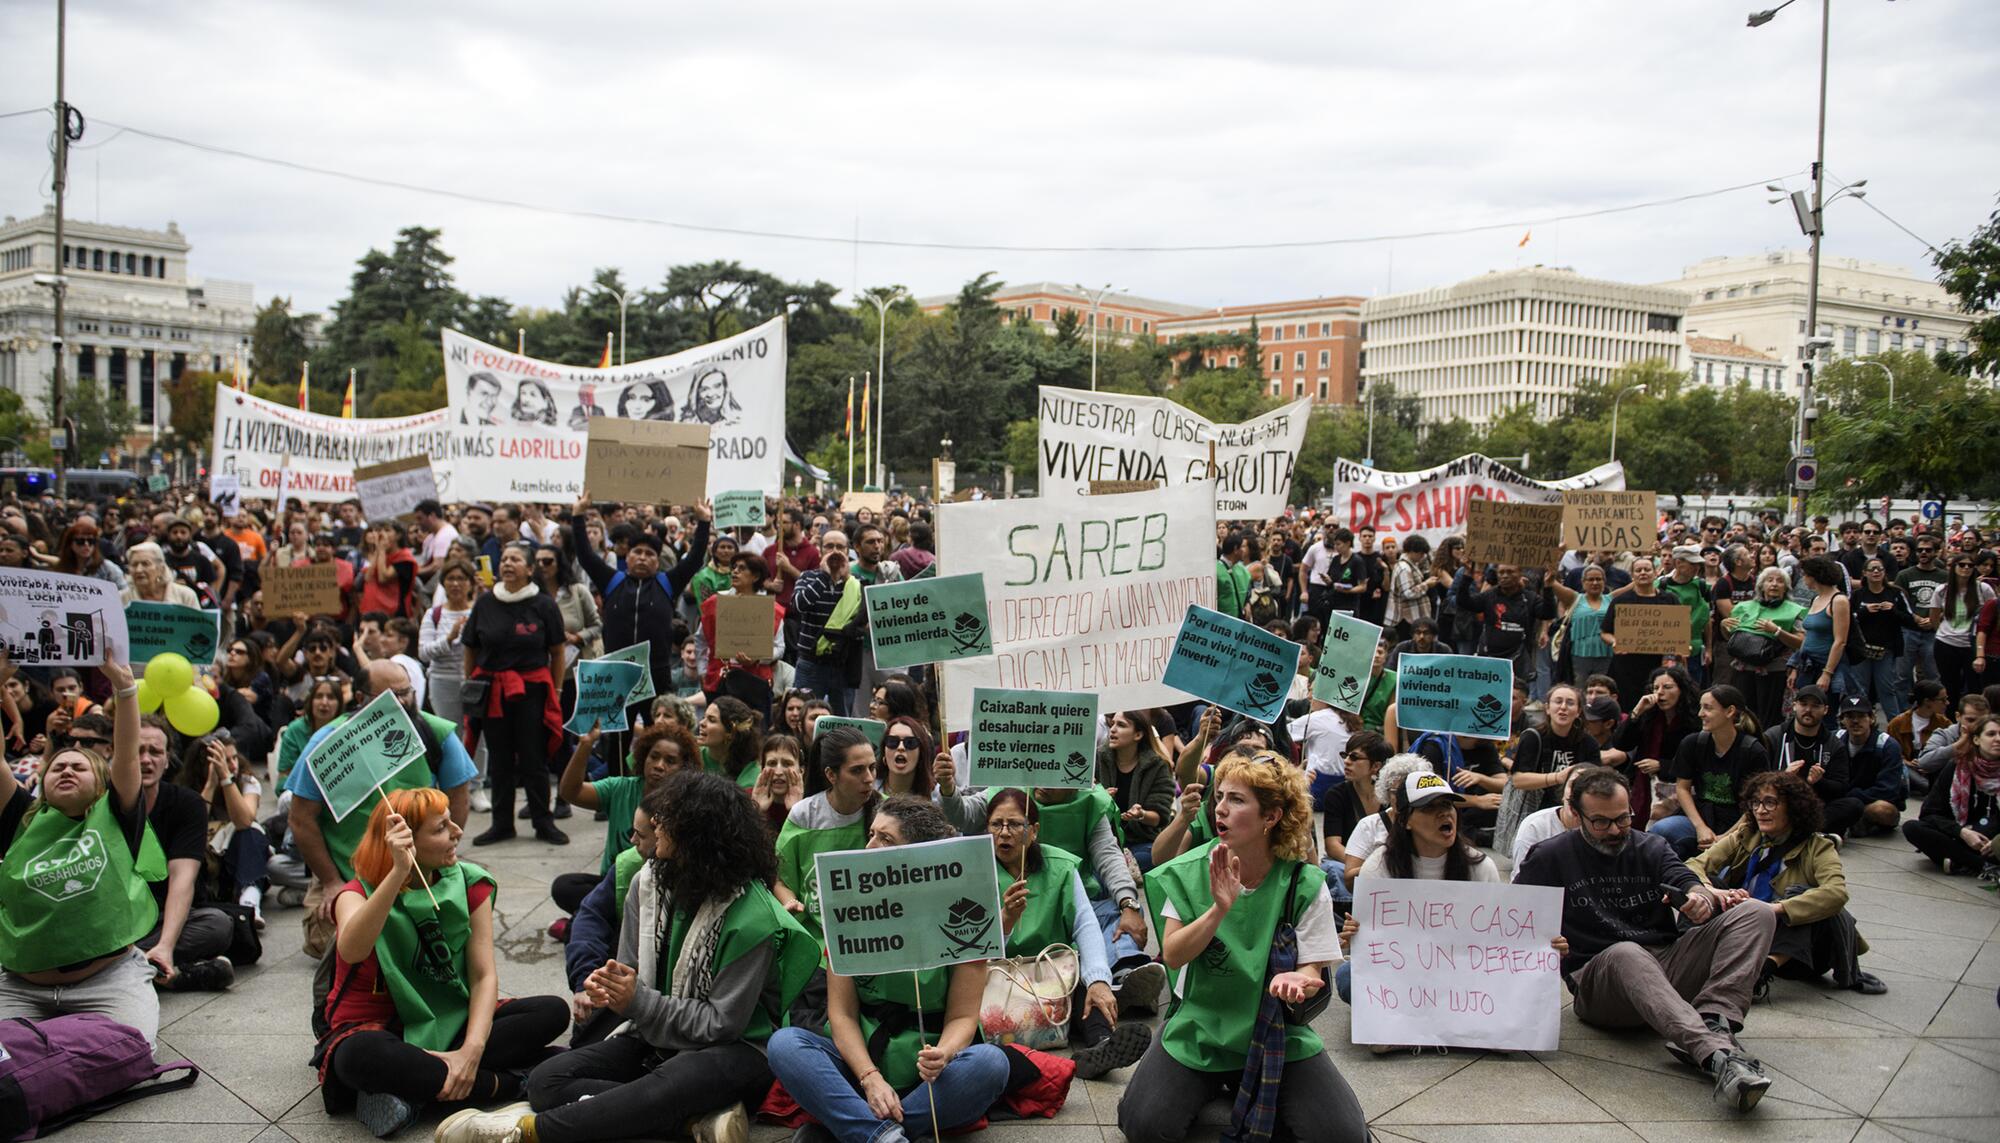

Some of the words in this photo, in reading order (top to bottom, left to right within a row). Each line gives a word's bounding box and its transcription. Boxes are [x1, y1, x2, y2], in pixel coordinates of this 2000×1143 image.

[452, 345, 468, 365] NI
[1041, 397, 1136, 437] NUESTRA
[1152, 409, 1210, 444] CLASE
[223, 417, 242, 450] LA
[246, 420, 311, 458] VIVIENDA
[314, 432, 349, 461] PARA
[464, 431, 495, 458] MÁS
[500, 438, 581, 460] LADRILLO
[1043, 438, 1168, 487] VIVIENDA
[1338, 462, 1371, 484] HOY
[1381, 474, 1408, 488] EN
[510, 480, 562, 493] Asamblea
[566, 482, 580, 493] de
[1565, 492, 1606, 506] VIVIENDA
[1470, 501, 1483, 514] EL
[1492, 502, 1560, 522] DOMINGO
[1577, 507, 1644, 521] TRAFICANTES
[1473, 517, 1486, 528] SE
[1492, 518, 1558, 534] MANIFIESTAN
[1575, 526, 1643, 549] VIDAS
[1004, 512, 1168, 587] SAREB
[28, 592, 63, 603] LUCHA
[56, 584, 103, 596] NUESTRA
[873, 600, 888, 612] La
[891, 597, 910, 610] ley
[913, 594, 929, 606] de
[1005, 591, 1094, 643] DERECHO
[1100, 588, 1115, 632] A
[1118, 582, 1161, 629] UNA
[1617, 607, 1662, 617] MUCHO
[130, 625, 143, 633] us
[178, 614, 214, 626] nuest
[875, 612, 929, 629] vivienda
[931, 610, 947, 621] es
[130, 637, 167, 646] mbién
[877, 636, 902, 647] una
[905, 627, 949, 643] mierda
[1188, 613, 1209, 630] Por
[1210, 622, 1233, 638] una
[1234, 631, 1282, 657] vivienda
[1333, 627, 1350, 642] de
[1637, 628, 1664, 637] PERO
[1177, 644, 1220, 669] invertir
[1181, 630, 1208, 647] para
[1210, 640, 1237, 659] vivir,
[1240, 650, 1255, 663] no
[1256, 657, 1284, 674] para
[998, 648, 1073, 690] DIGNA
[1081, 644, 1107, 689] EN
[1403, 665, 1441, 679] ¡Abajo
[1443, 668, 1455, 678] el
[1457, 668, 1503, 685] trabajo,
[581, 672, 593, 684] La
[1402, 680, 1452, 693] vivienda
[980, 699, 1047, 715] CaixaBank
[1050, 704, 1090, 719] quiere
[1401, 695, 1460, 710] universal!
[979, 719, 1050, 734] desahuciar
[1052, 726, 1060, 735] a
[1063, 722, 1083, 736] Pili
[312, 755, 328, 769] Por
[328, 738, 345, 756] una
[344, 708, 385, 741] vivienda
[978, 740, 1007, 753] este
[1009, 740, 1056, 754] viernes
[319, 760, 338, 782] para
[338, 743, 360, 764] vivir,
[360, 734, 374, 747] no
[375, 717, 397, 738] para
[977, 757, 1061, 772] #PilarSeQueda
[325, 761, 356, 793] invertir
[33, 856, 103, 888] DESAHUCIOS
[830, 869, 852, 891] El
[858, 861, 963, 894] gobierno
[833, 899, 904, 924] vende
[1570, 896, 1596, 908] LOS
[1369, 890, 1459, 931] TENER
[1470, 904, 1536, 940] CASA
[954, 929, 970, 937] PAH
[969, 926, 981, 935] VK
[838, 934, 904, 955] humo
[1368, 941, 1406, 971] ES
[1417, 943, 1456, 970] UN
[1468, 945, 1560, 975] DERECHO
[1367, 984, 1399, 1010] NO
[1409, 985, 1438, 1009] UN
[1449, 990, 1495, 1016] LUJO
